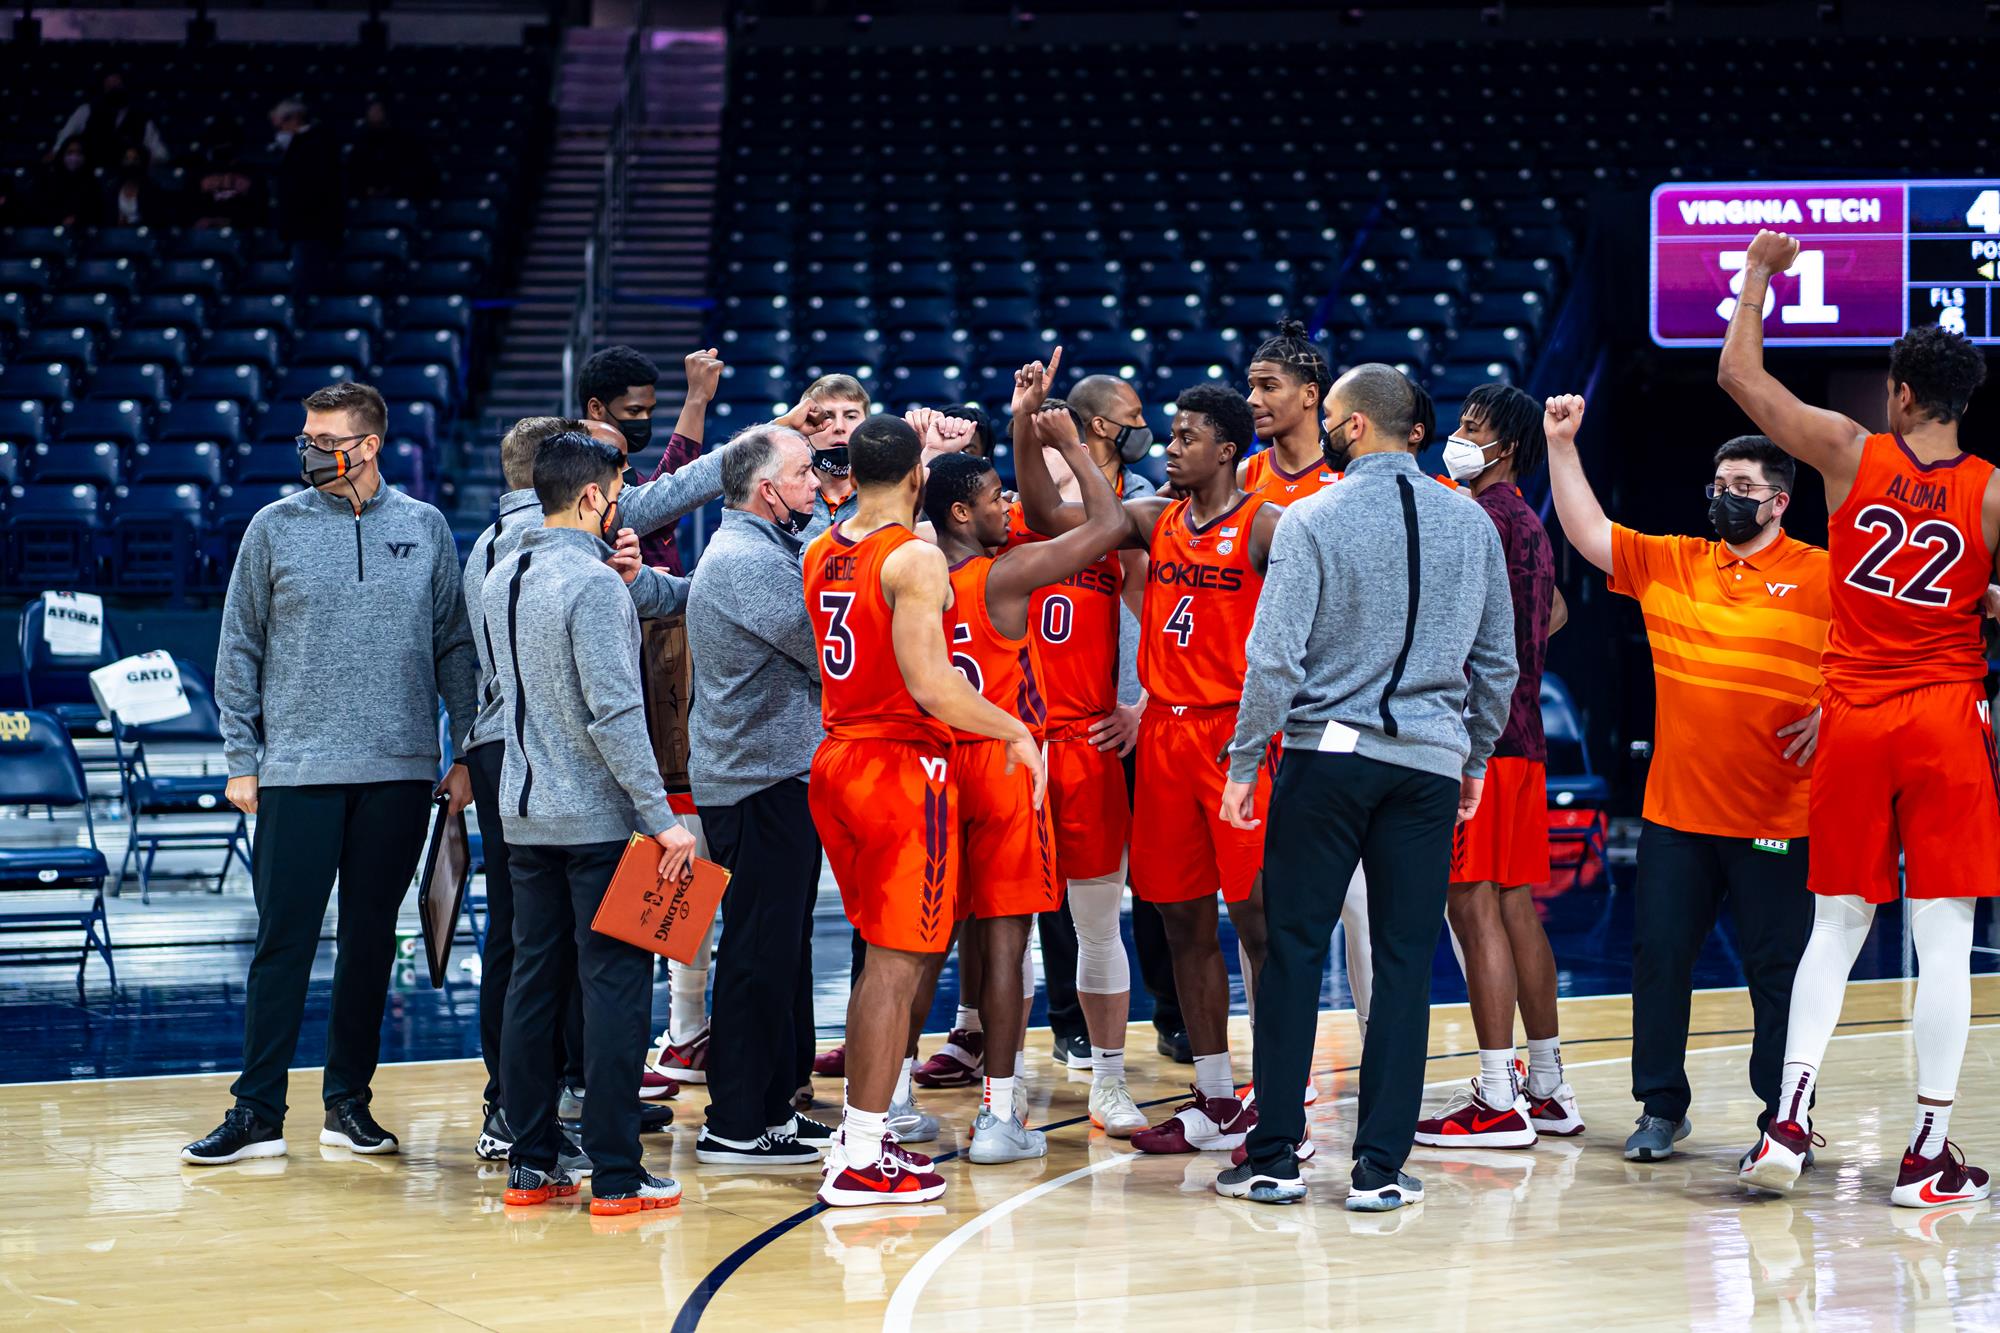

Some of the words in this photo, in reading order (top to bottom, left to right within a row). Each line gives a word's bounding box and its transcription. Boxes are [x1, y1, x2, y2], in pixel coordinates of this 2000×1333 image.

[1679, 199, 1803, 225] VIRGINIA
[1807, 198, 1881, 223] TECH
[1971, 240, 2000, 260] PO
[1715, 250, 1840, 325] 31
[1930, 287, 1965, 308] FLS
[1886, 474, 1947, 512] ALUMA
[385, 542, 419, 559] VT
[1845, 504, 1965, 607] 22
[825, 556, 856, 581] BEDE
[1148, 560, 1244, 591] HOKIES
[1765, 582, 1798, 597] VT
[1041, 594, 1073, 644] 0
[1163, 595, 1194, 647] 4
[820, 592, 856, 680] 3
[126, 669, 173, 684] GATO
[919, 756, 948, 783] VT
